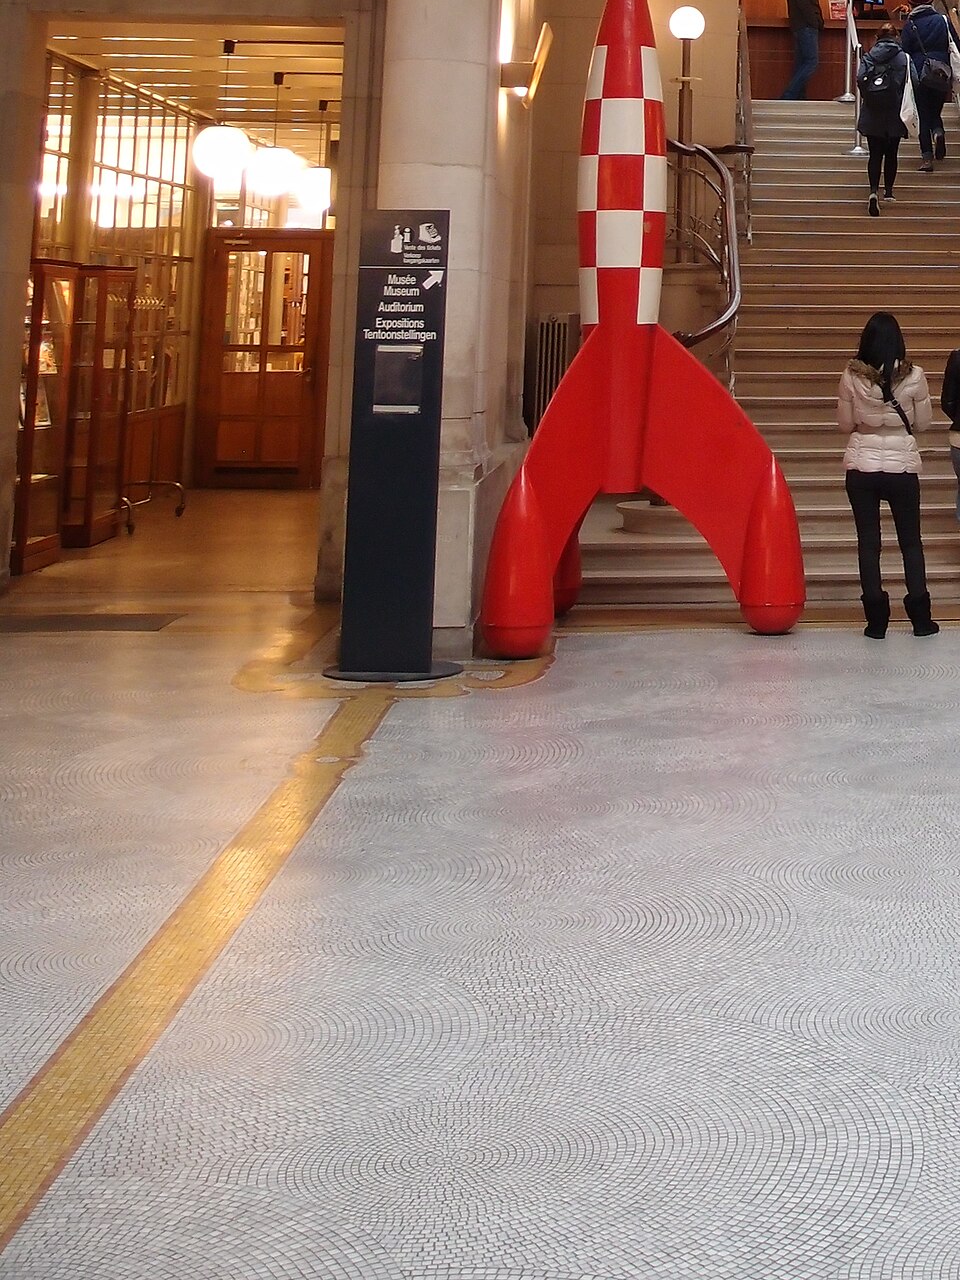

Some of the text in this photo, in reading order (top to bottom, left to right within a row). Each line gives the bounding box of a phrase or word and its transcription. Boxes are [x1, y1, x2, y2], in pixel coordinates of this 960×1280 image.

[388, 274, 417, 284] Musée
[383, 286, 420, 295] Museum
[378, 302, 424, 312] Auditorium
[375, 317, 425, 330] Expositions
[363, 329, 437, 342] Tentoonstellingen
